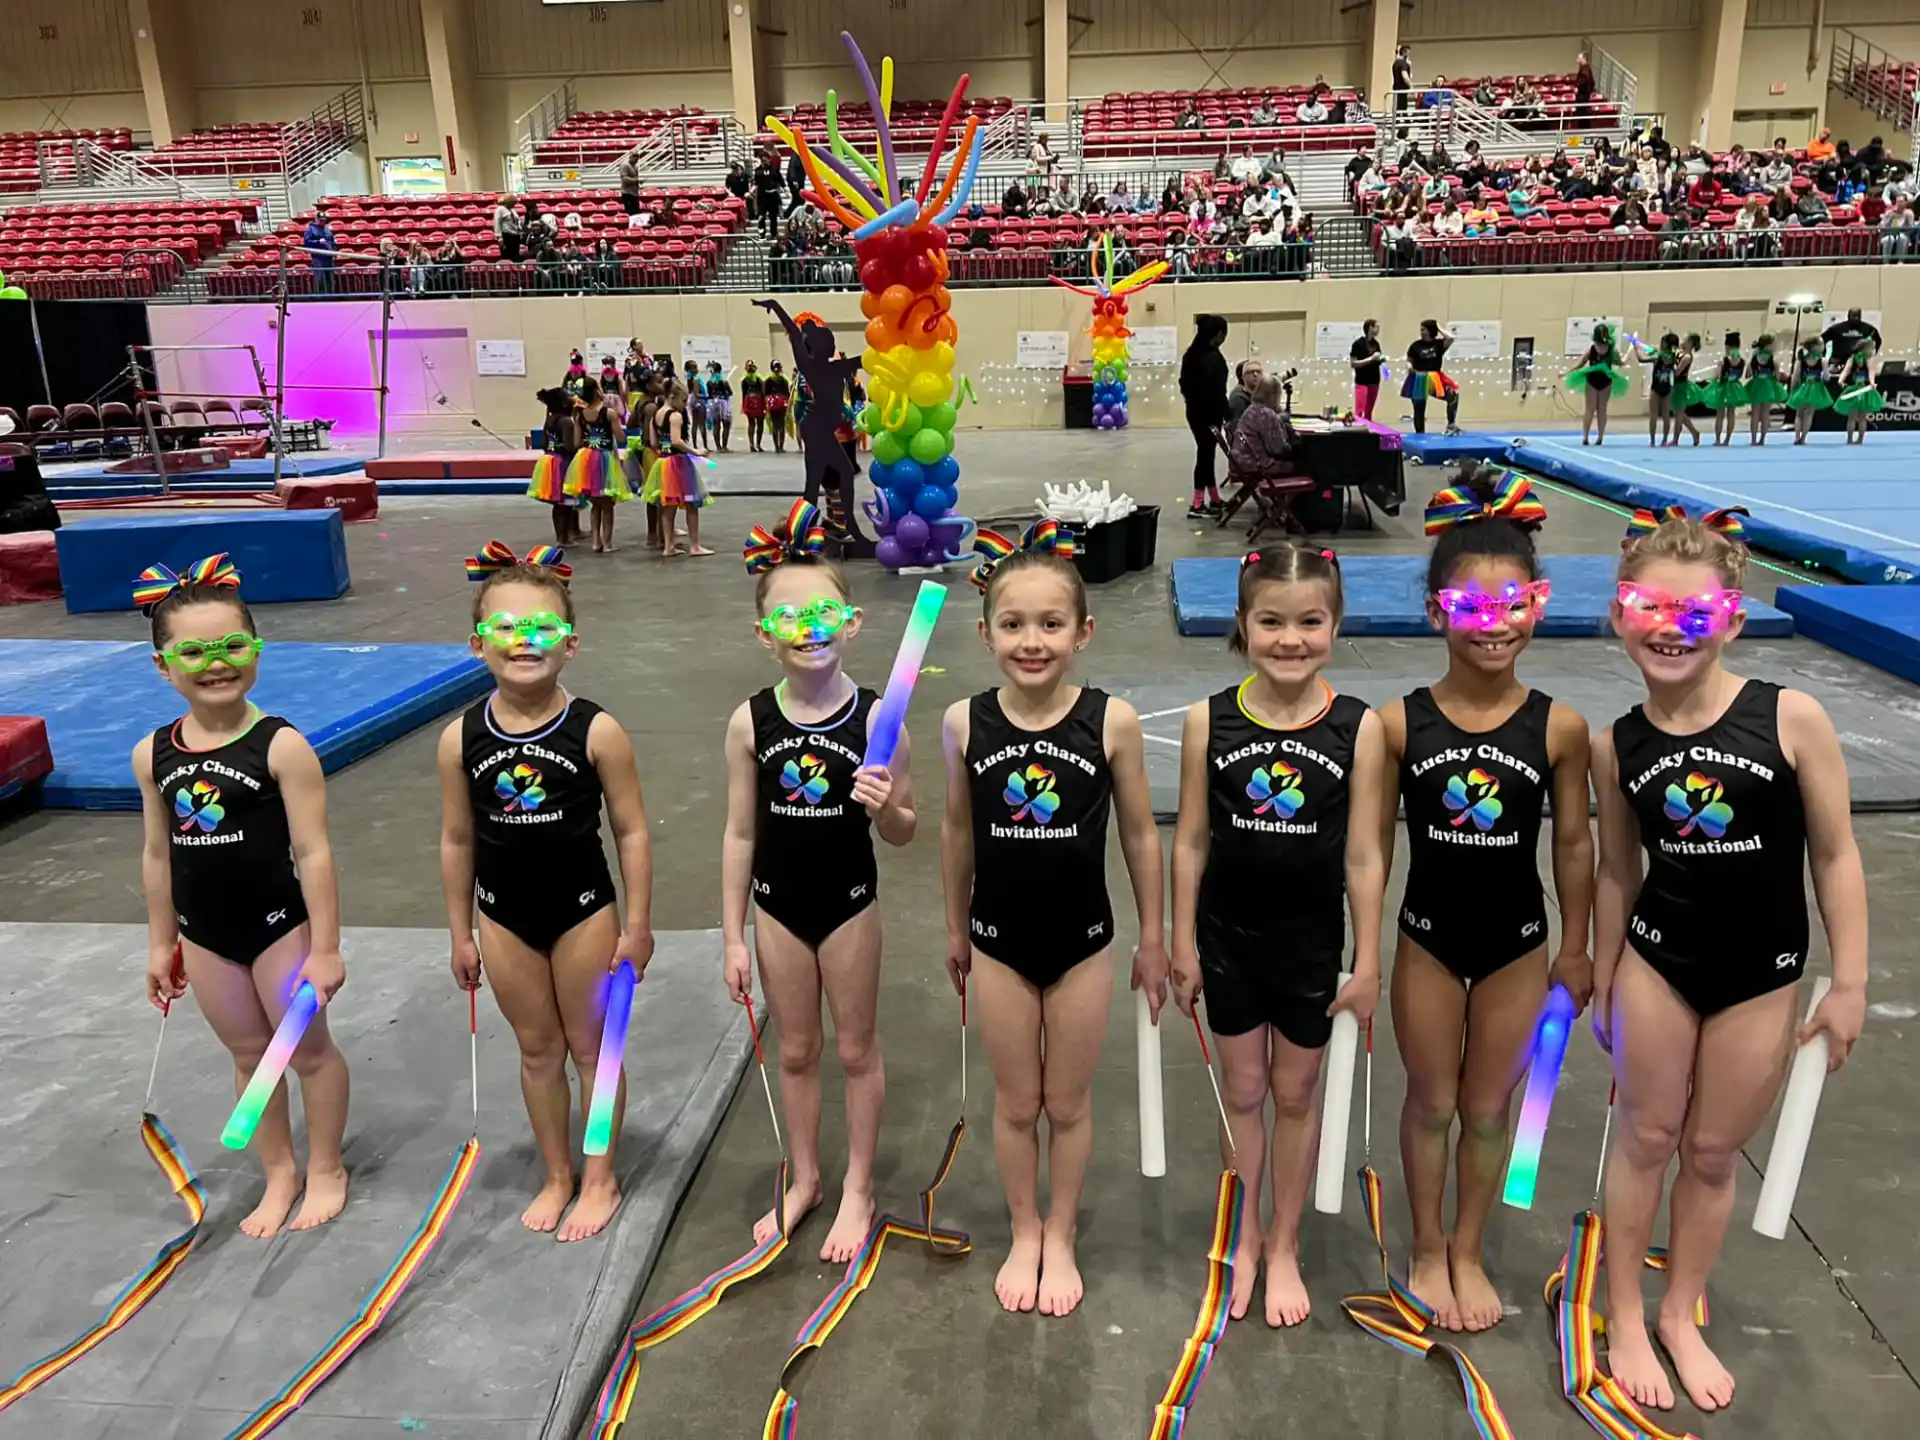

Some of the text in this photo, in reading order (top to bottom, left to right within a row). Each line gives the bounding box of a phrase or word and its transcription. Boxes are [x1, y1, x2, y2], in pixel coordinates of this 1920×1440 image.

[1866, 412, 1920, 421] ODUCTIO
[472, 743, 578, 780] Lucky Charm
[758, 733, 862, 766] Lucky Charm
[973, 740, 1097, 777] Lucky Charm
[1214, 739, 1344, 780] Lucky Charm
[202, 760, 261, 791] Charm
[1411, 744, 1540, 785] Lucky Charm
[1628, 746, 1775, 794] Lucky Charm
[770, 801, 843, 817] Invitational
[990, 822, 1078, 839] Invitational
[1231, 813, 1317, 834] Invitational
[1428, 824, 1519, 847] Invitational
[1659, 834, 1763, 855] Invitational
[972, 917, 998, 938] 10.0
[1403, 907, 1432, 931] 10.0
[1631, 915, 1662, 943] 10.0
